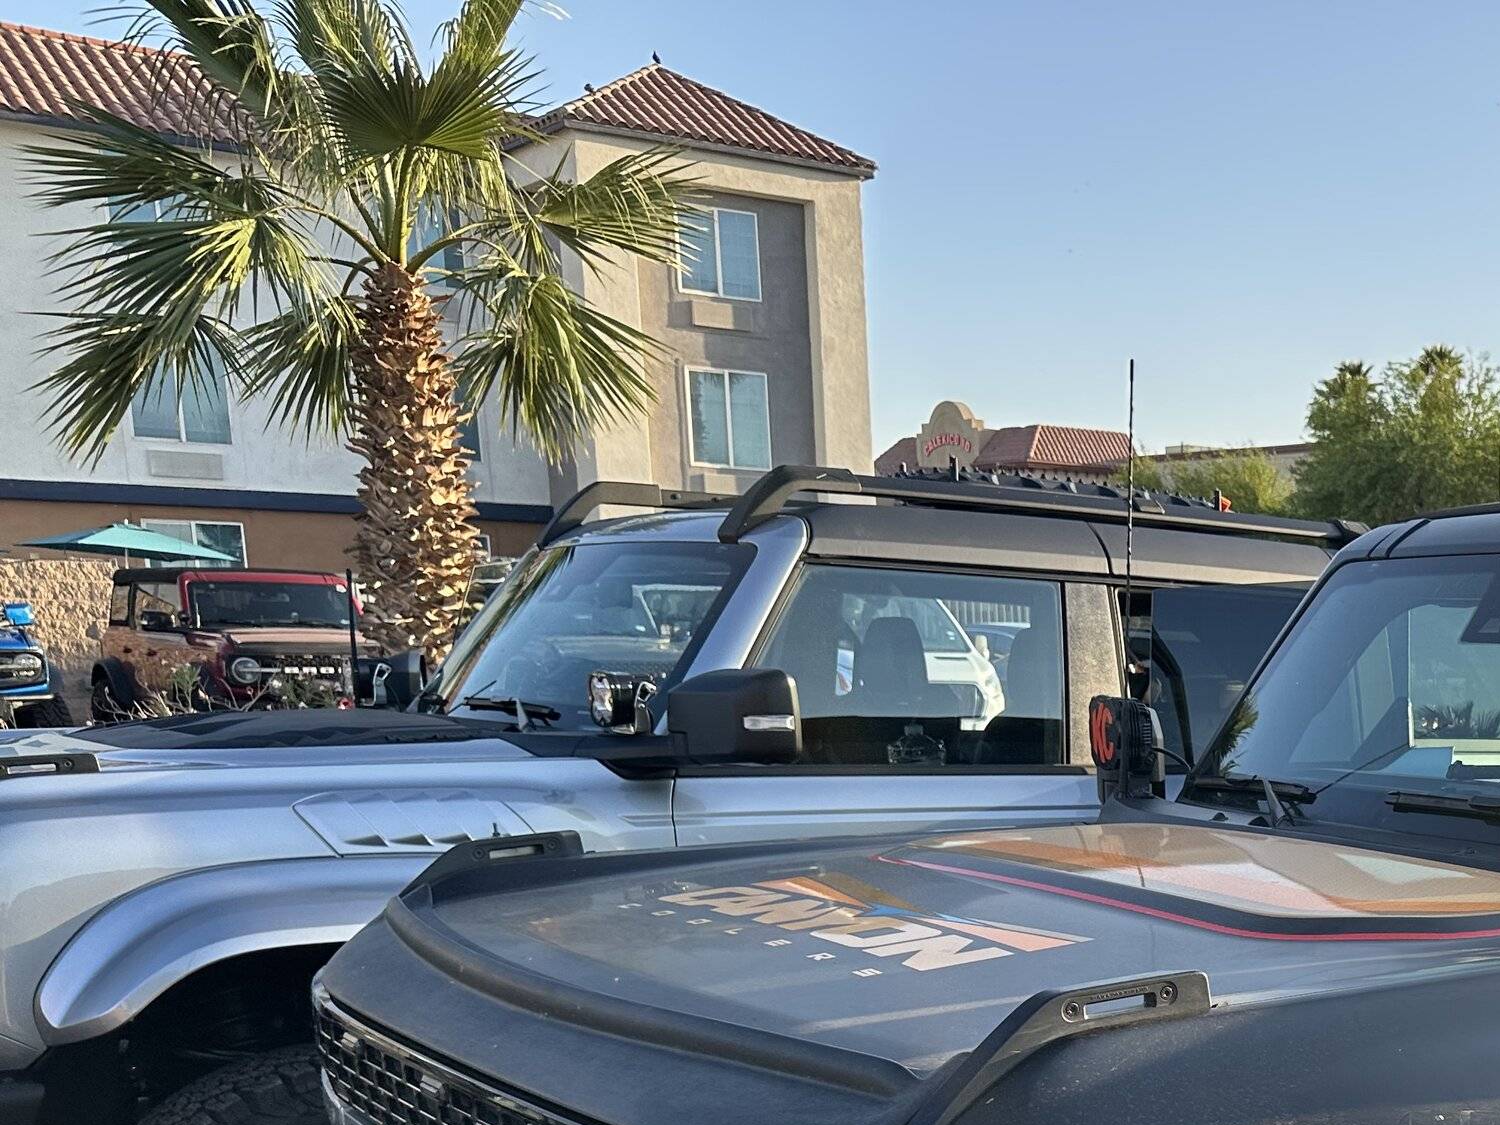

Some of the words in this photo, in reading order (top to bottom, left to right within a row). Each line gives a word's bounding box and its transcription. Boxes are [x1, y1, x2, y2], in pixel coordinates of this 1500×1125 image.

[924, 433, 961, 457] CALEXICO
[1091, 702, 1115, 764] KC
[657, 886, 1014, 971] CANYON
